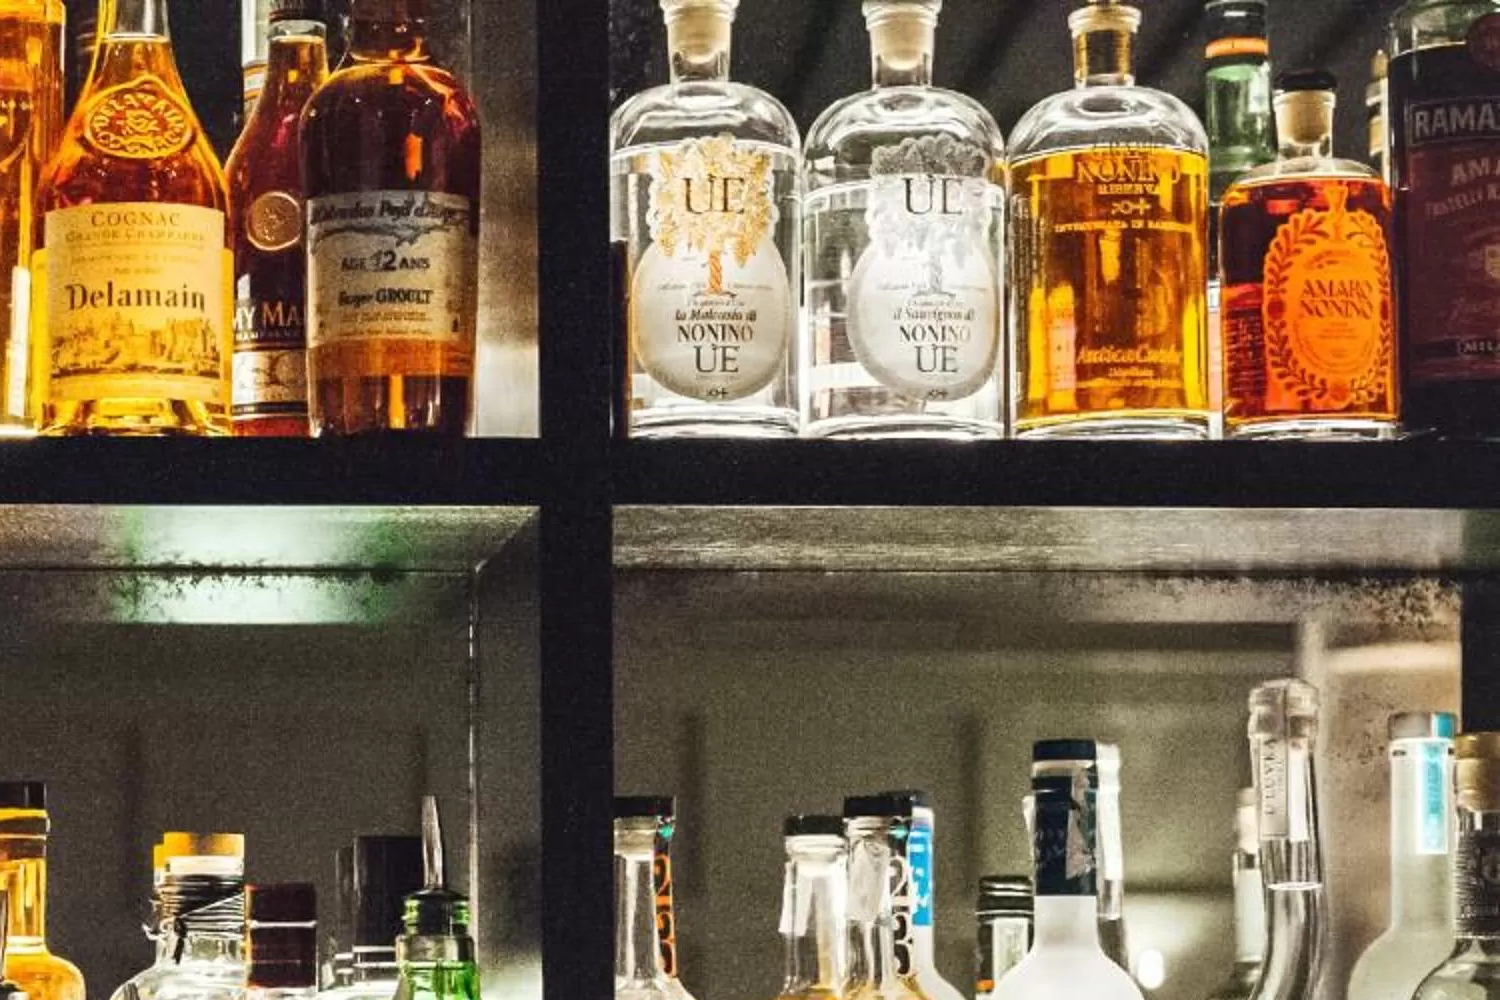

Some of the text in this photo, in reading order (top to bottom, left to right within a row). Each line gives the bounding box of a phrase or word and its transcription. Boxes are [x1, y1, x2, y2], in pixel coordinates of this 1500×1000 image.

[1414, 102, 1500, 138] RAMA
[90, 211, 181, 228] COGNAC
[399, 256, 430, 270] ANS
[64, 280, 206, 312] Delamain
[677, 322, 754, 342] NONINO
[899, 323, 971, 342] NONINO
